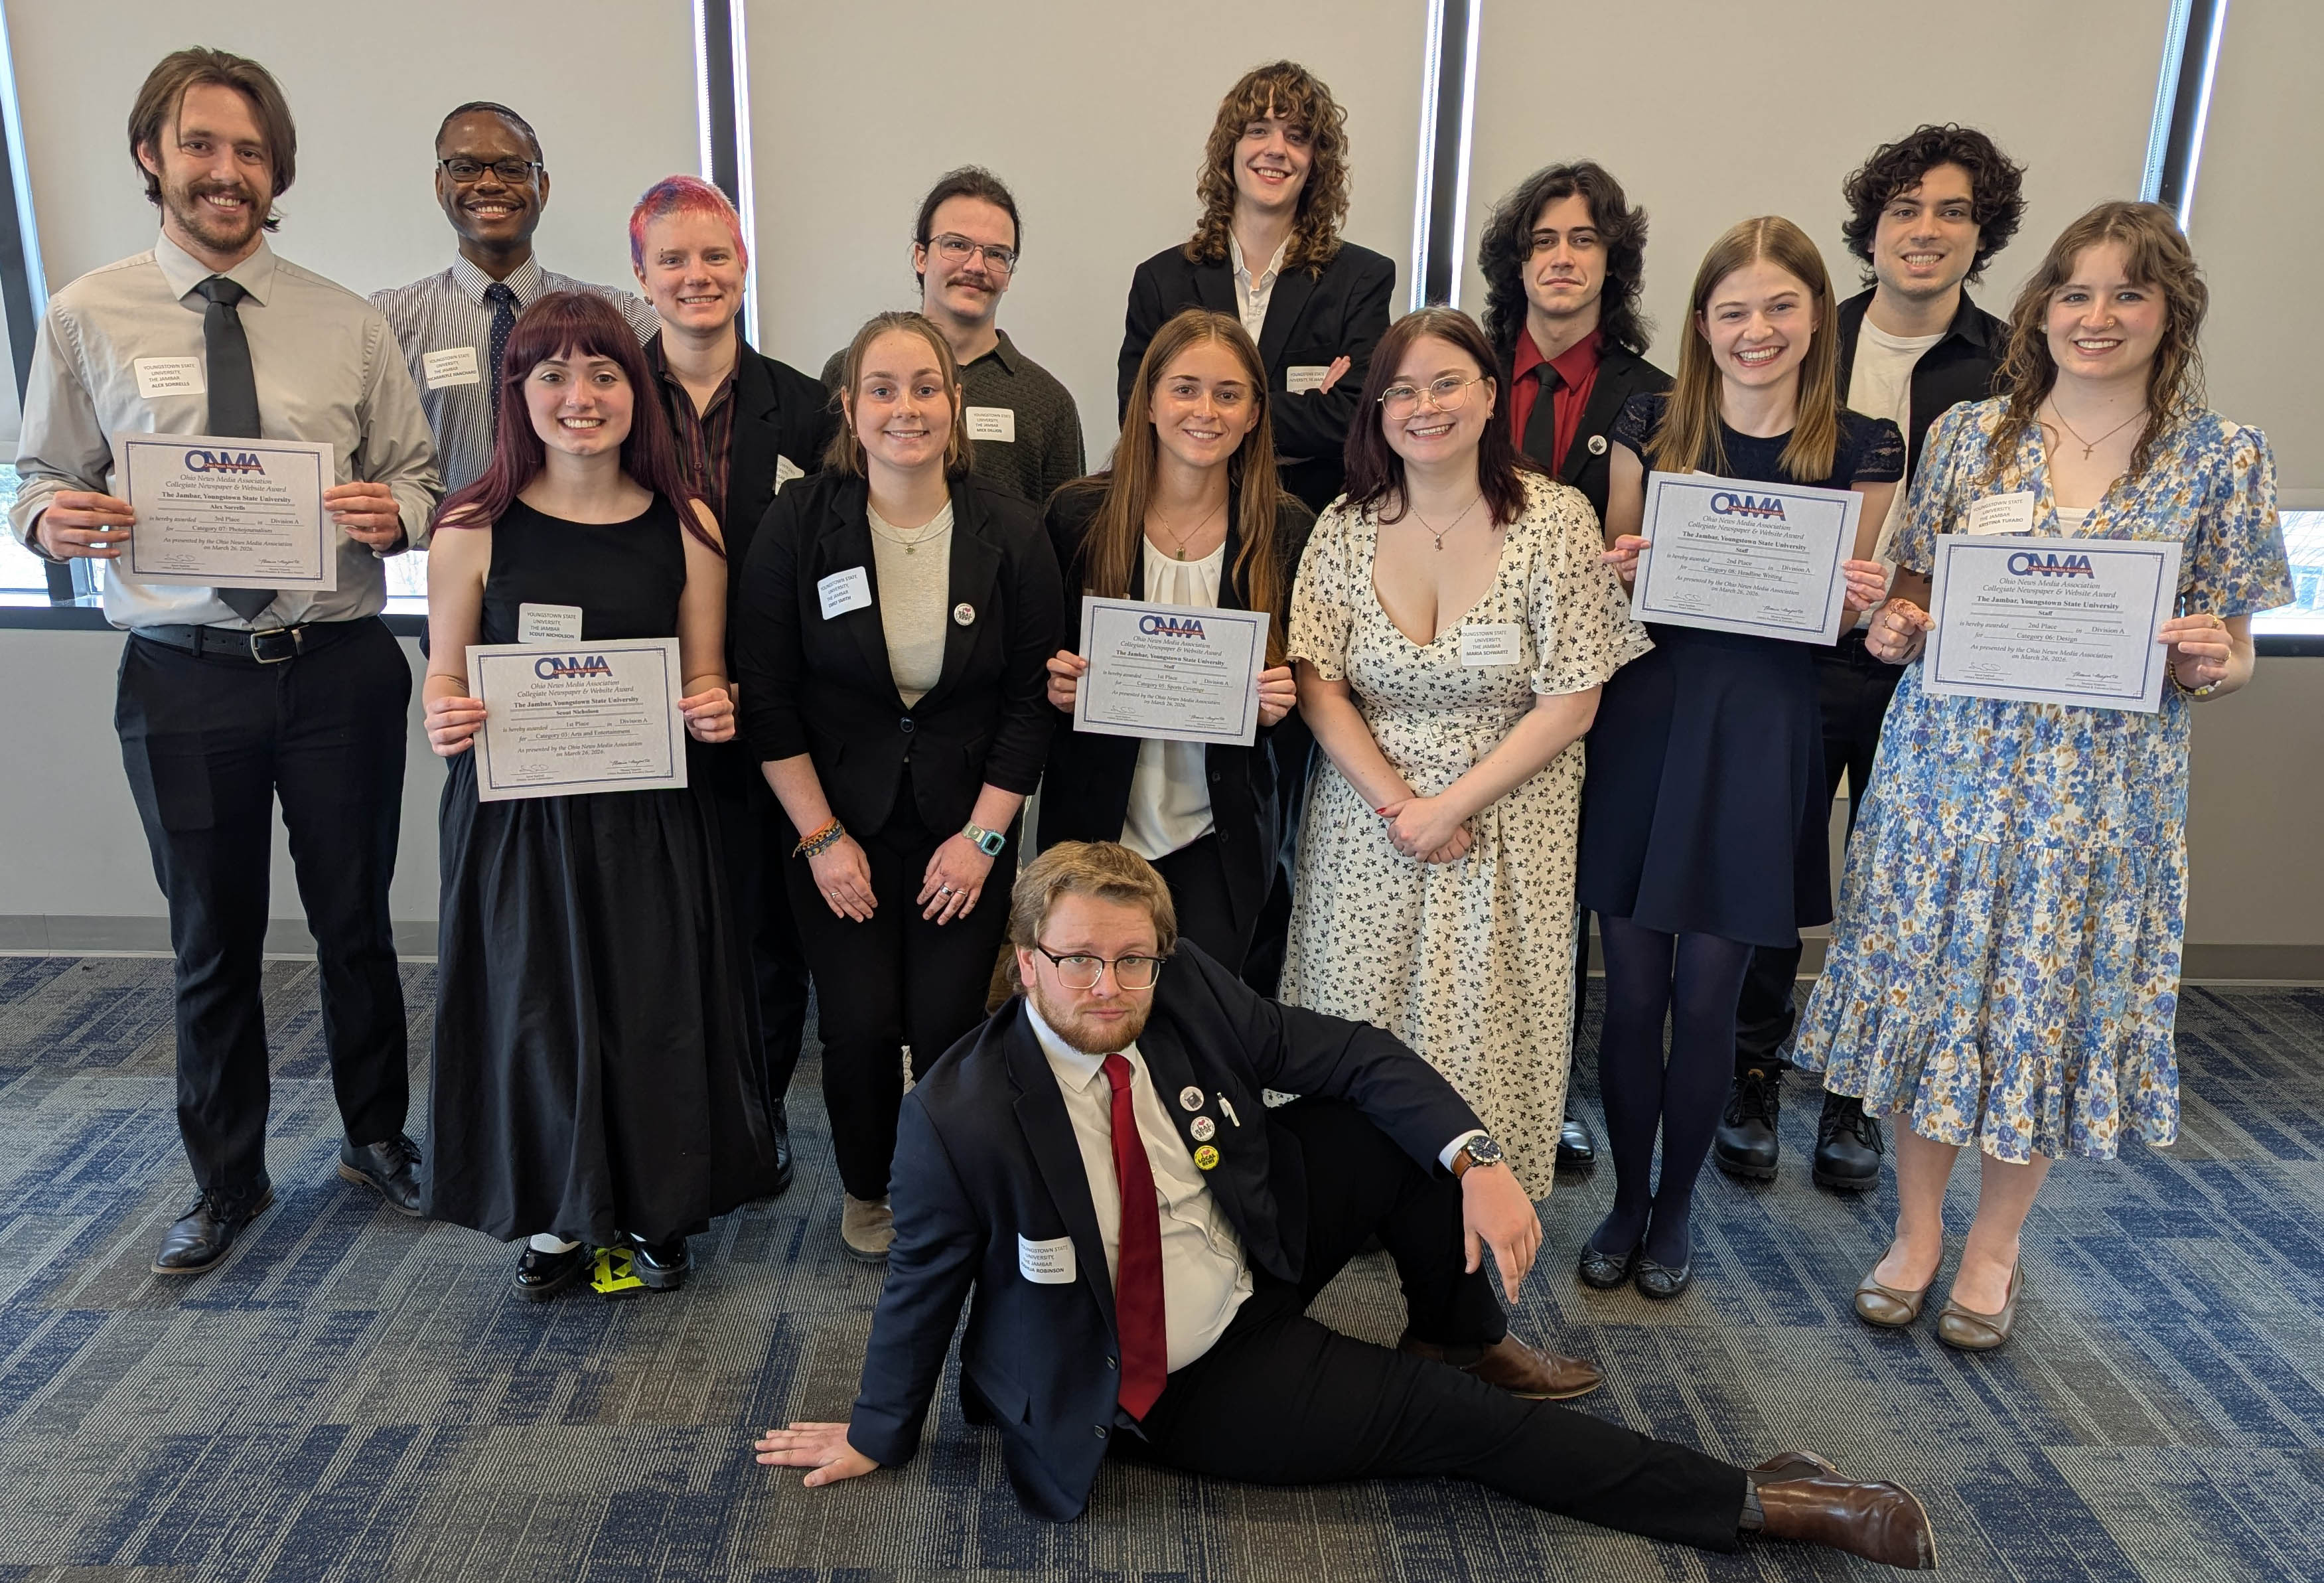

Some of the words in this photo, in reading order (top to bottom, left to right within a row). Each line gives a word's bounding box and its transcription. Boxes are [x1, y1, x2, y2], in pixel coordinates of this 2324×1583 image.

[165, 481, 196, 489] Collegiate
[198, 482, 232, 491] Newspaper
[203, 493, 242, 502] Youngstown
[259, 495, 291, 504] University
[1973, 500, 2007, 512] YOUNGSTOWN
[1688, 520, 1717, 530] Collegiate
[1717, 524, 1751, 534] Newspaper
[1759, 528, 1782, 537] Website
[1756, 522, 1790, 530] Association
[1720, 535, 1756, 545] Youngstown
[1775, 541, 1806, 552] University
[1982, 584, 2015, 593] Collegiate
[2017, 586, 2054, 595] Newspaper
[2021, 597, 2061, 608] Youngstown
[2083, 601, 2119, 611] University
[1120, 641, 1146, 649] Collegiate
[1146, 643, 1175, 652] Newspaper
[1150, 652, 1181, 661] Youngstown
[1197, 658, 1224, 666] University
[517, 690, 547, 699] Collegiate
[607, 696, 638, 705] University
[1195, 1124, 1212, 1134] REAL
[1198, 1154, 1216, 1164] LOCAL
